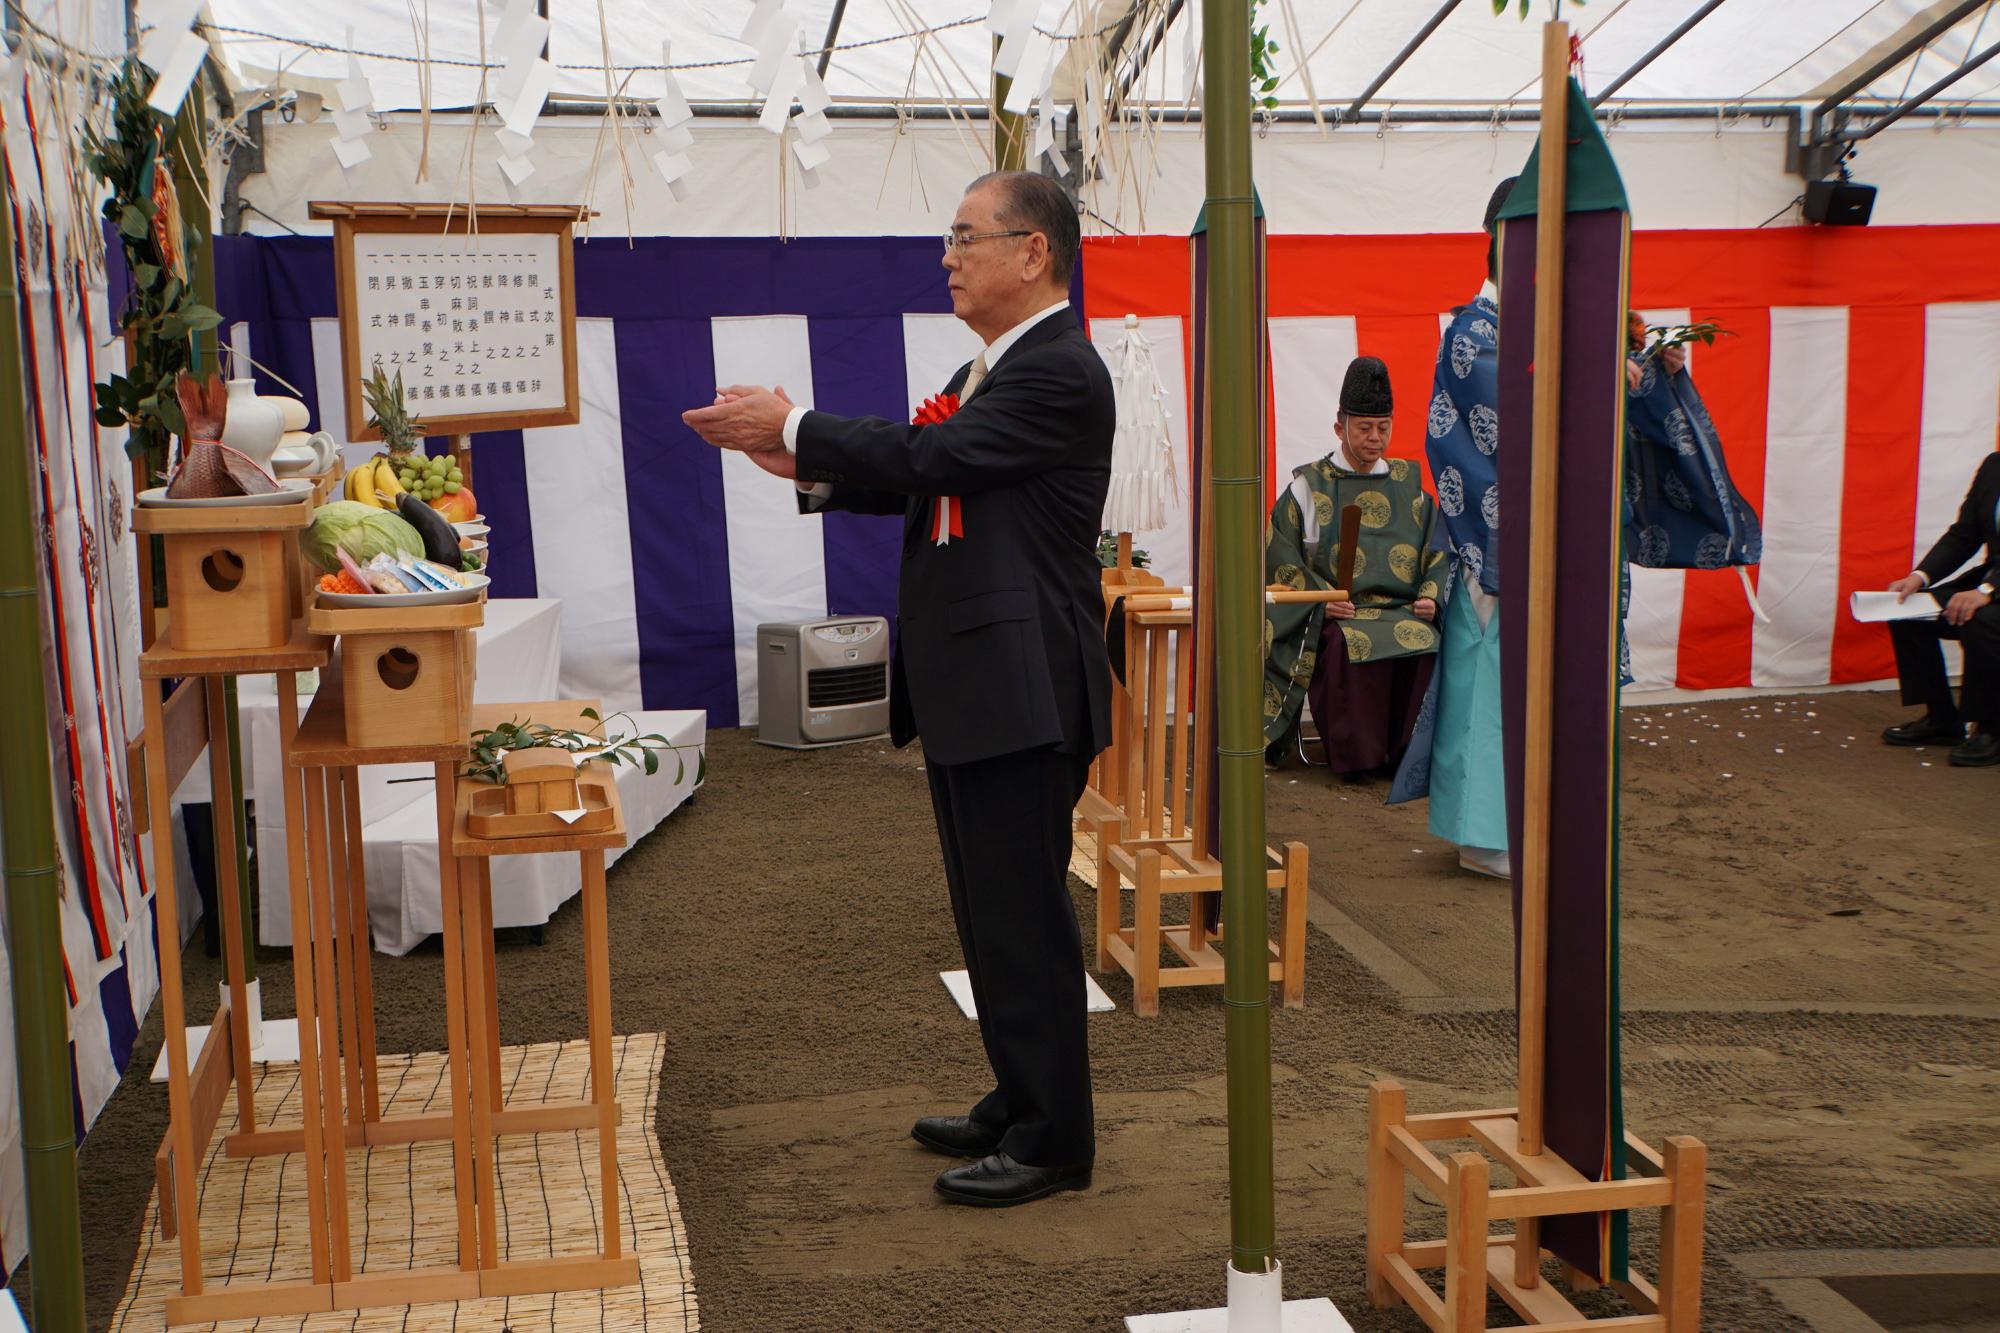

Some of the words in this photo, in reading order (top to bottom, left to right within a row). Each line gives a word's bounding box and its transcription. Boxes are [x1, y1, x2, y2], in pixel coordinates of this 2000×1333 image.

[367, 254, 383, 365] 一、閉式之
[384, 254, 400, 364] 一、昇神之
